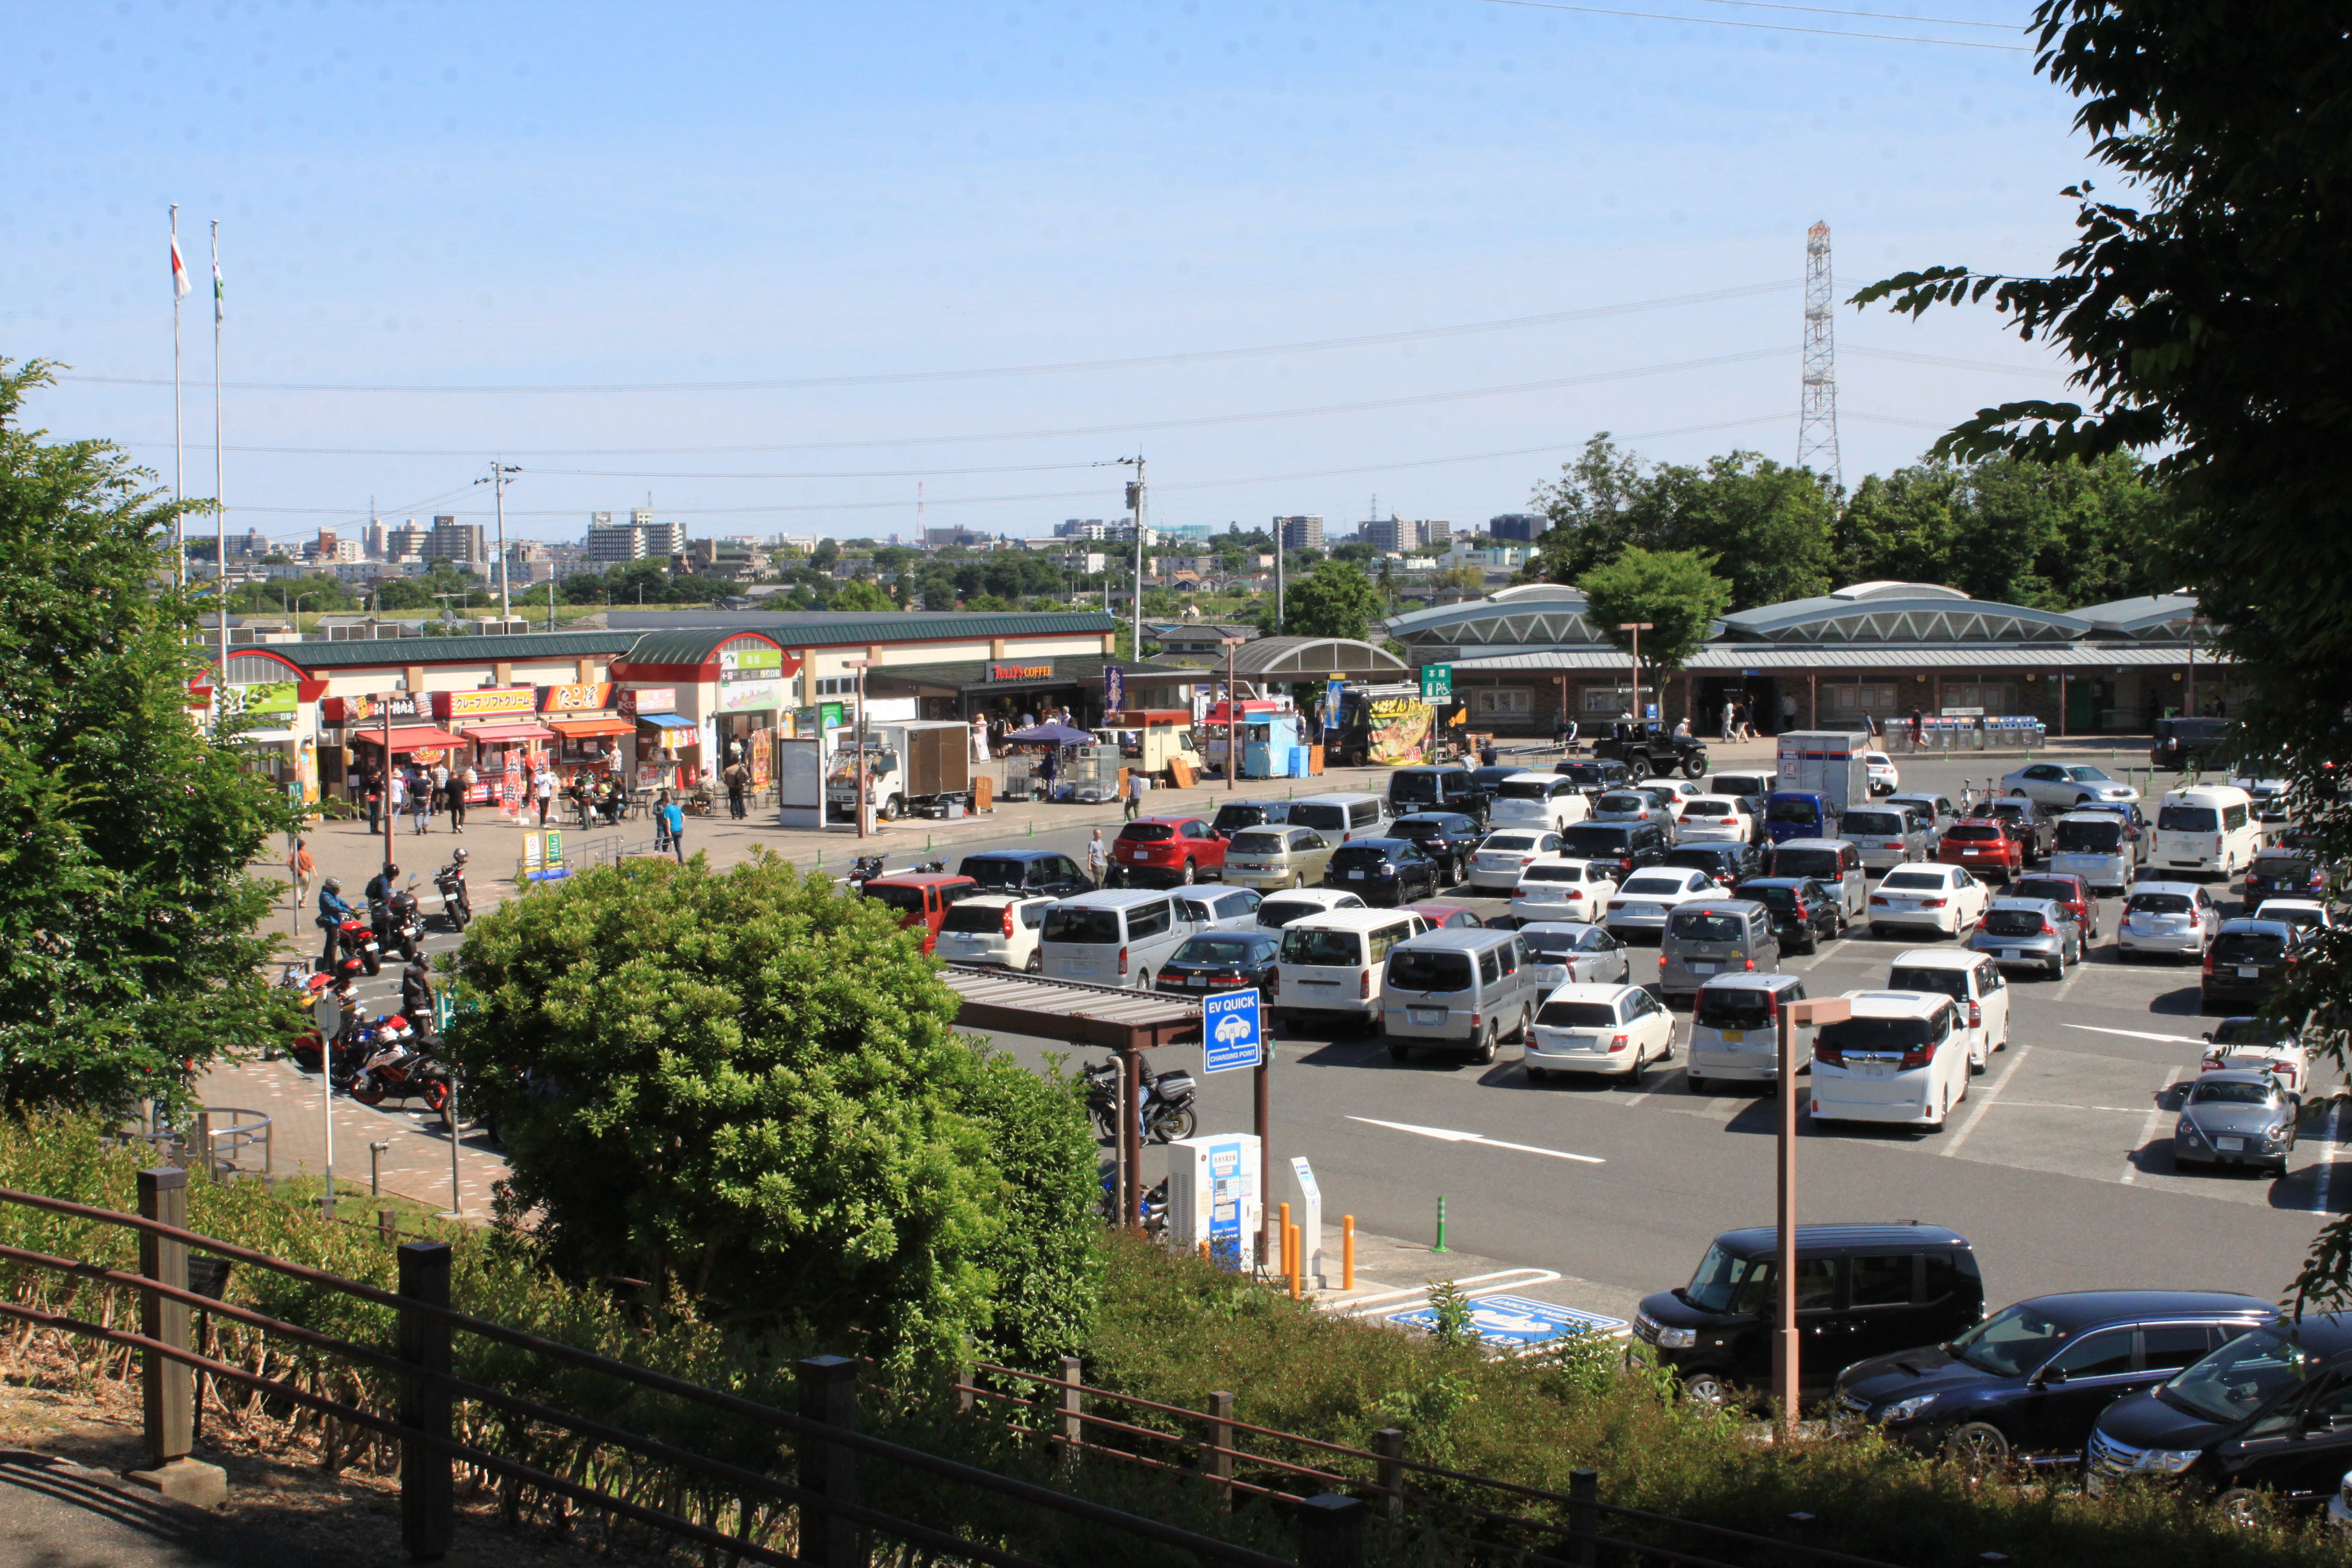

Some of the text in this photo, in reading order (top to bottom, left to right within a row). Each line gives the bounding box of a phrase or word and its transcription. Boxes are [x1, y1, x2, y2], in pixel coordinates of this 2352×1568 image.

[1024, 666, 1052, 677] COFFEE
[1436, 683, 1442, 695] P
[501, 756, 519, 804] 牛串
[1209, 995, 1255, 1014] EV QUICK
[1210, 1049, 1255, 1063] CHARGING POINT
[1491, 1300, 1535, 1311] POINT
